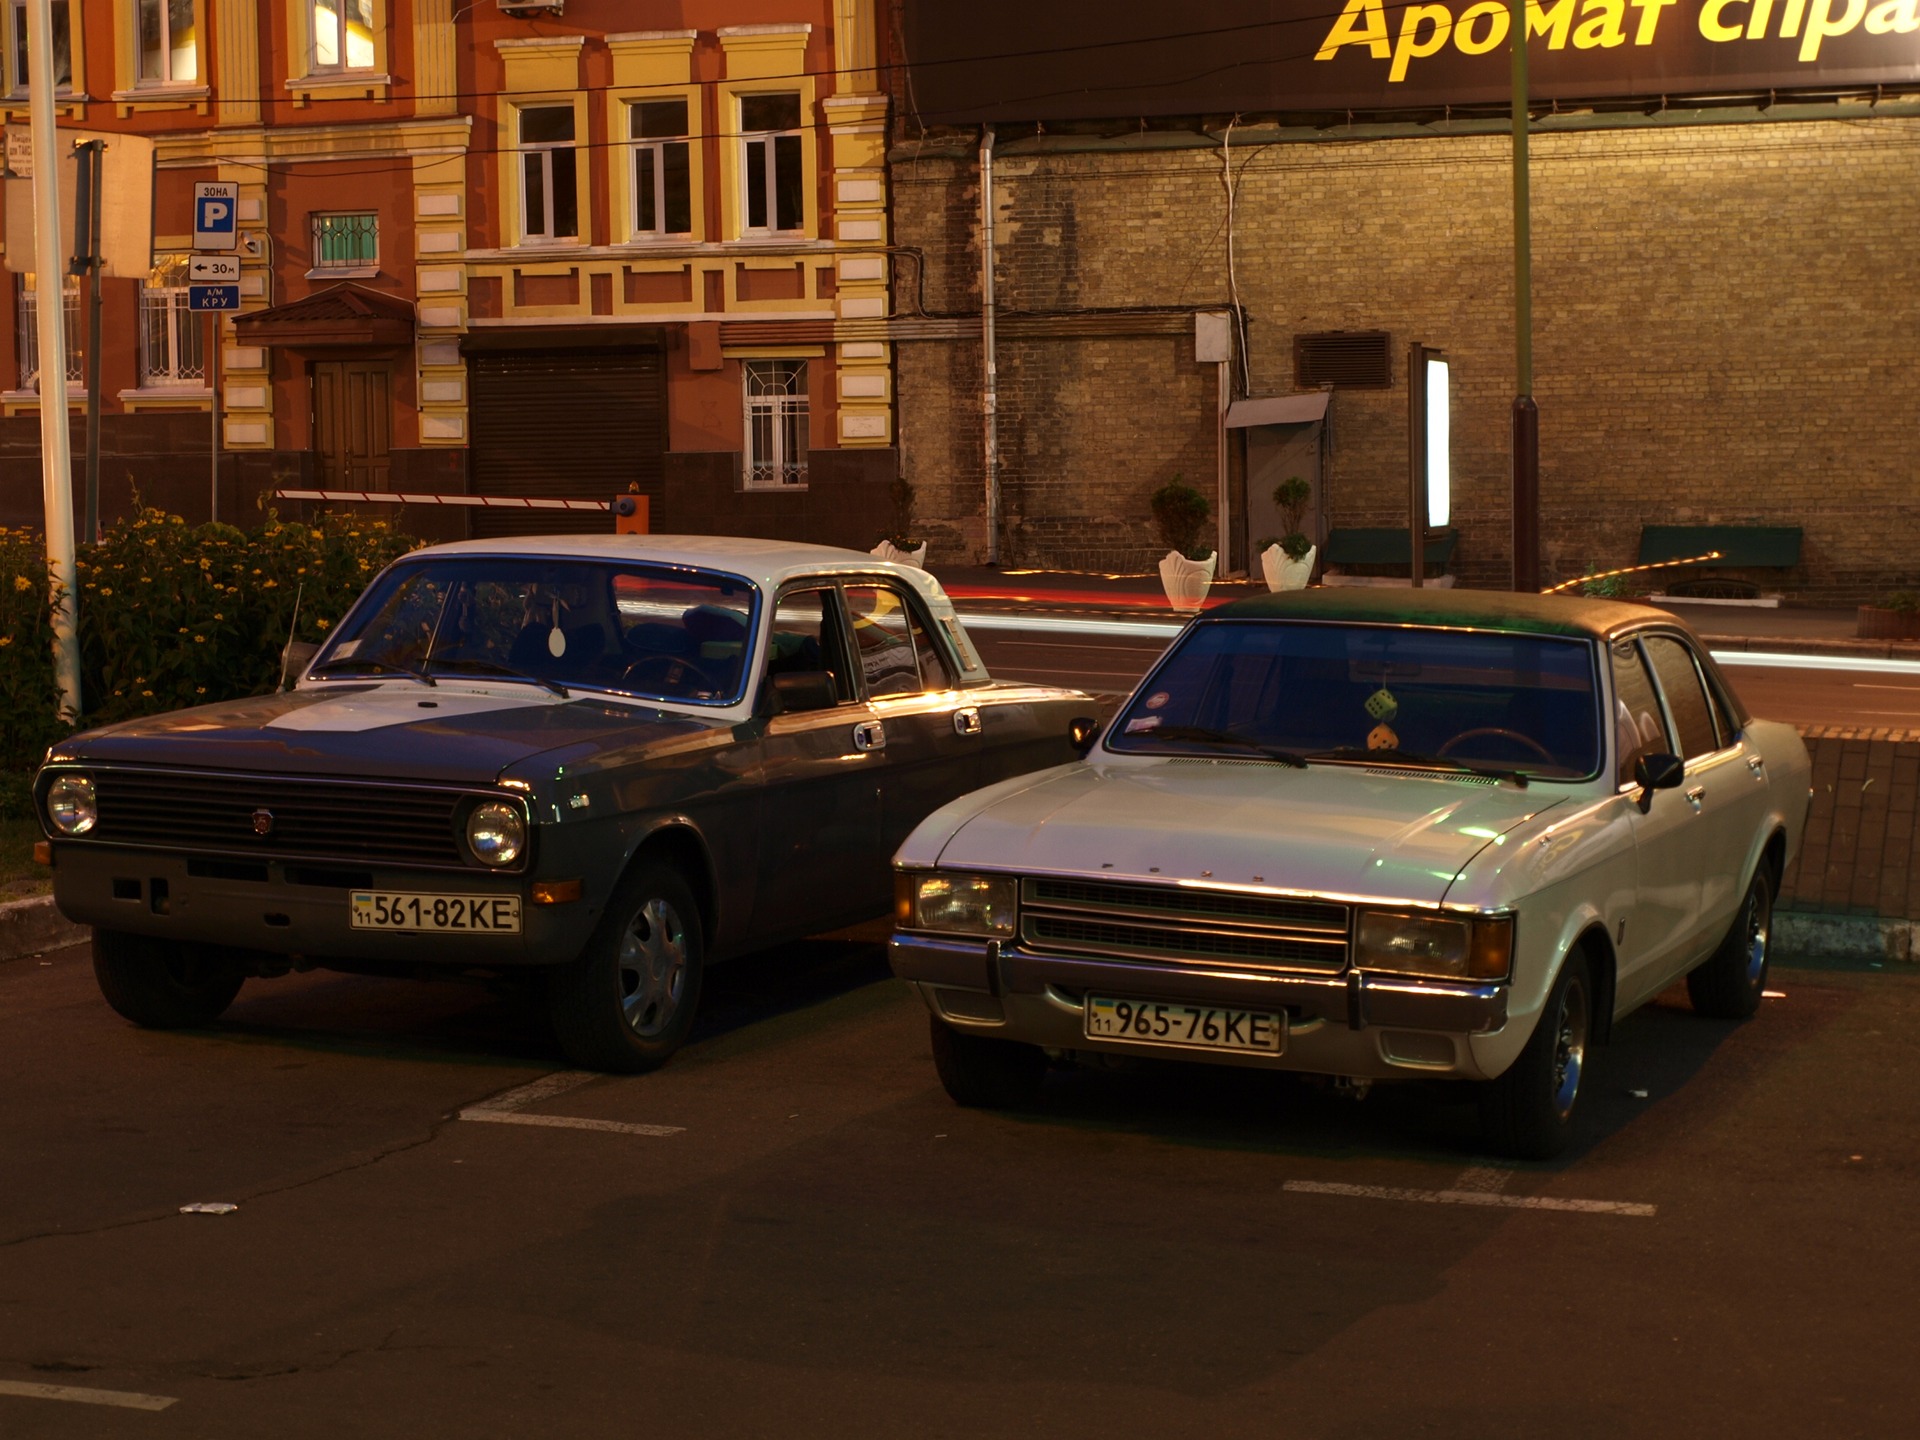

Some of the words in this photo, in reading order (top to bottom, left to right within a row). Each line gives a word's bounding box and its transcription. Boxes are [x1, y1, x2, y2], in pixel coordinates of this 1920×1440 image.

[1313, 0, 1676, 82] Аромат
[204, 187, 228, 197] ЗОНА
[204, 202, 228, 228] P
[202, 298, 228, 307] КРУ
[207, 288, 223, 297] А/М
[357, 912, 371, 924] 11
[374, 896, 513, 929] 561-82KE
[1094, 1018, 1111, 1032] 11
[1115, 1002, 1271, 1046] 965-76KE
